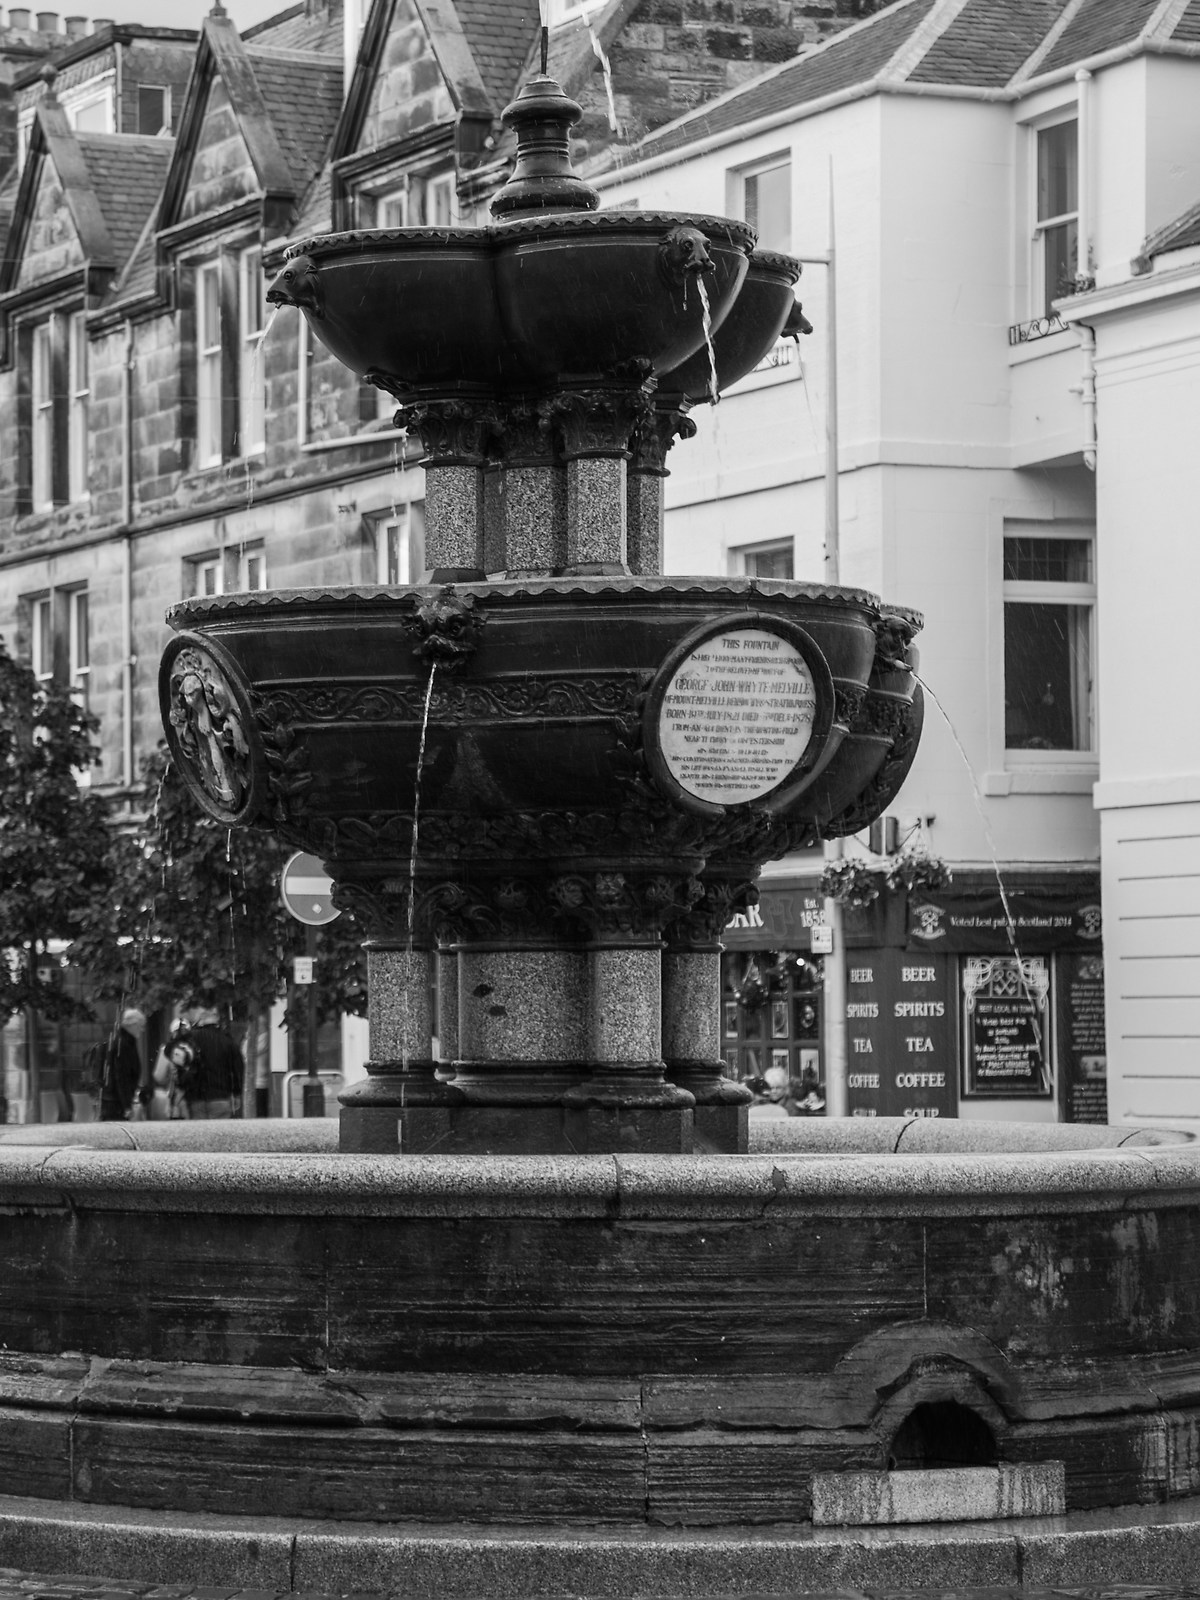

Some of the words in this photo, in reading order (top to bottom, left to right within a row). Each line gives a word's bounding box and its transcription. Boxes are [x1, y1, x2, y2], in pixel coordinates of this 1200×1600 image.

[722, 638, 740, 649] THIS
[743, 639, 780, 651] FOUNTAIN
[675, 678, 709, 691] GEORGE
[711, 679, 736, 692] JOHN
[738, 680, 769, 693] WHYTE
[771, 681, 810, 695] MELVILLE
[666, 708, 686, 719] BORN
[803, 897, 819, 909] Est.
[950, 916, 975, 928] Voted
[975, 916, 992, 928] best
[993, 917, 1008, 930] pub
[1017, 916, 1052, 928] Scotland
[1054, 916, 1072, 928] 2014
[850, 967, 874, 983] BEER
[901, 966, 936, 982] BEER
[847, 1002, 879, 1018] SPIRITS
[894, 1001, 945, 1017] SPIRITS
[853, 1037, 873, 1053] TEA
[905, 1036, 935, 1052] TEA
[848, 1073, 880, 1089] COFFEE
[895, 1072, 946, 1088] COFFEE
